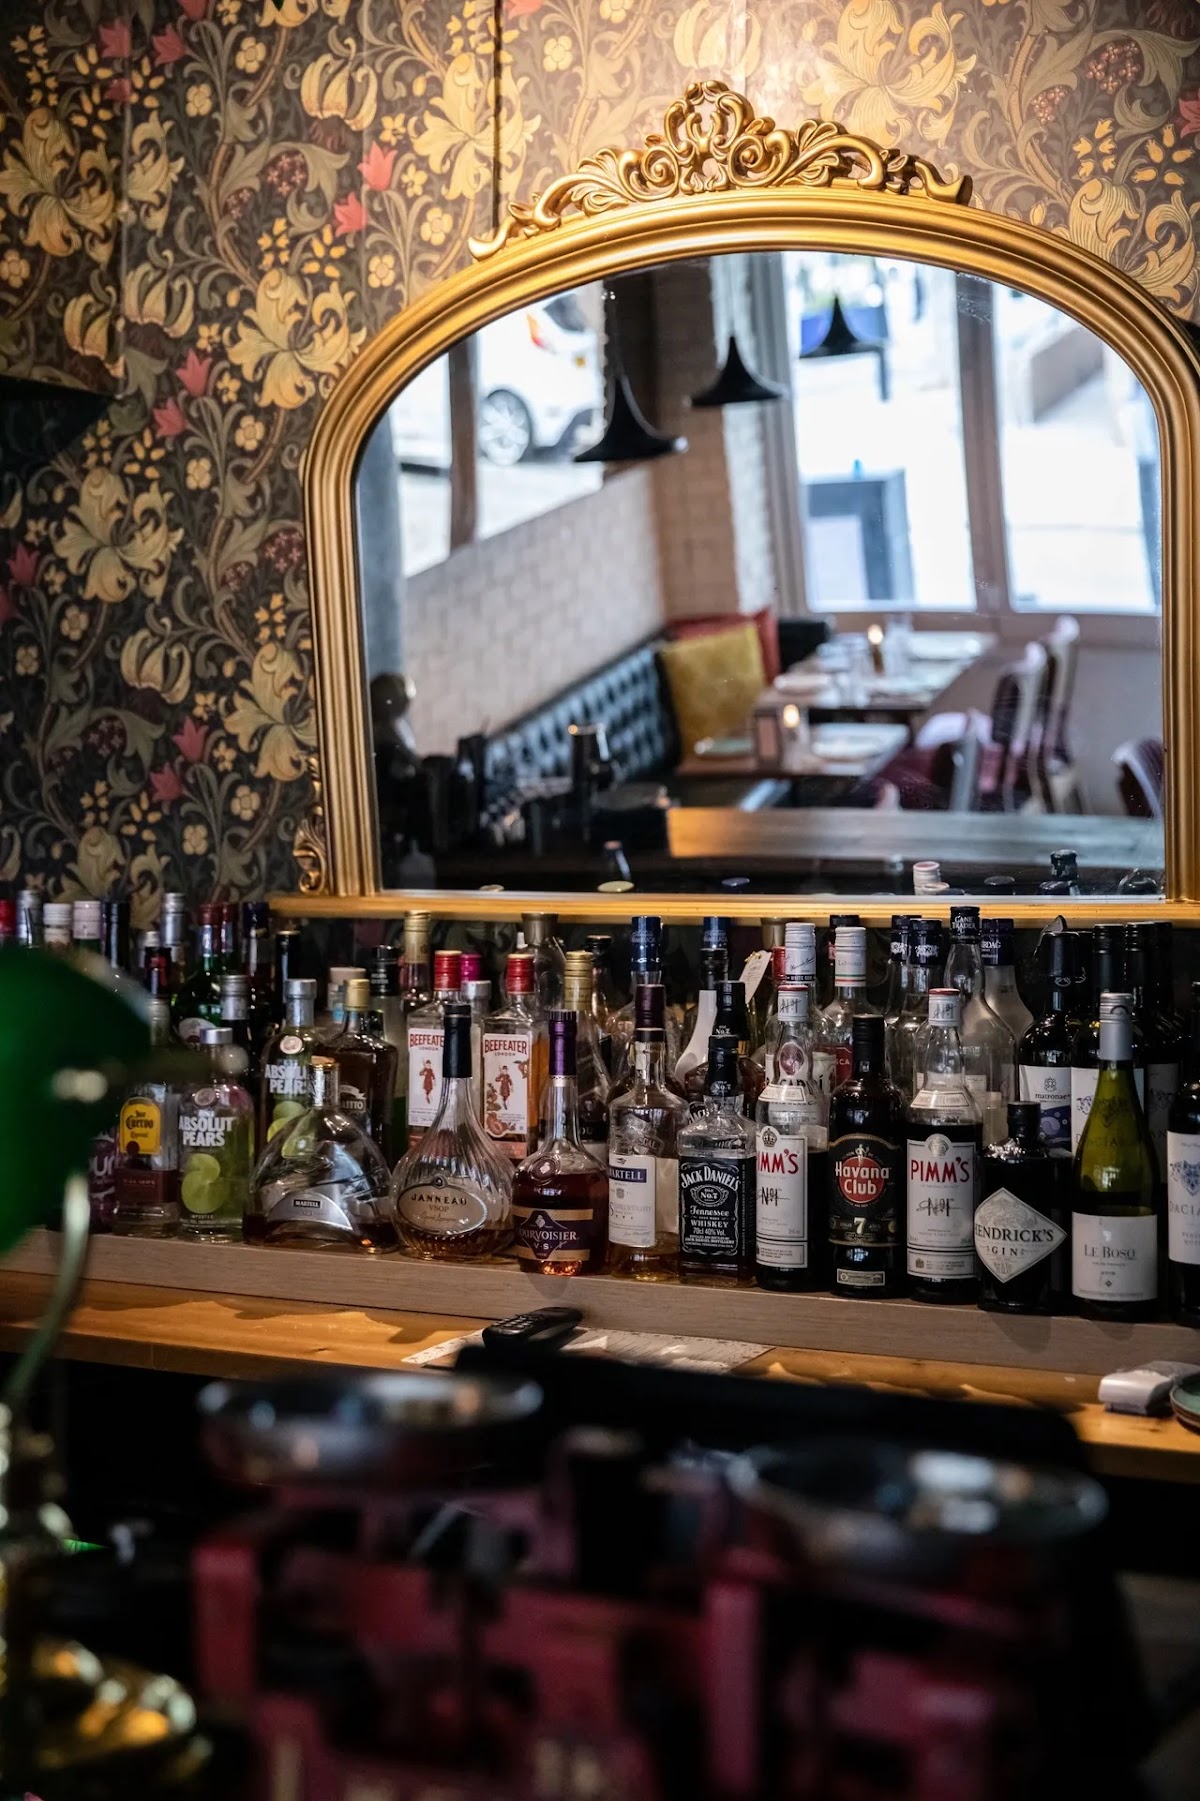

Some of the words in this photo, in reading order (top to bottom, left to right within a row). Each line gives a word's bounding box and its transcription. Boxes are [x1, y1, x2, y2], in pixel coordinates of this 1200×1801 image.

[409, 1033, 444, 1048] BEEFEATE
[484, 1039, 528, 1055] BEEFEATER
[125, 1115, 154, 1130] Cuervo
[178, 1115, 237, 1132] ABSOLUT
[182, 1131, 226, 1147] PEARS
[757, 1148, 799, 1175] IMM'S
[609, 1166, 644, 1181] ARTELL
[835, 1161, 890, 1180] Havana
[910, 1156, 970, 1184] PIMM'S
[680, 1170, 703, 1189] JACK
[703, 1165, 741, 1192] DANIEL'S
[843, 1178, 877, 1195] Club
[294, 1200, 320, 1209] MARTELL
[411, 1193, 468, 1206] JANNEAU
[429, 1204, 450, 1212] VSOP
[689, 1205, 730, 1217] Tennessee
[690, 1219, 729, 1228] WHISKEY
[853, 1216, 866, 1235] 7
[518, 1229, 577, 1242] OURVOISIER
[991, 1245, 1018, 1256] GIN
